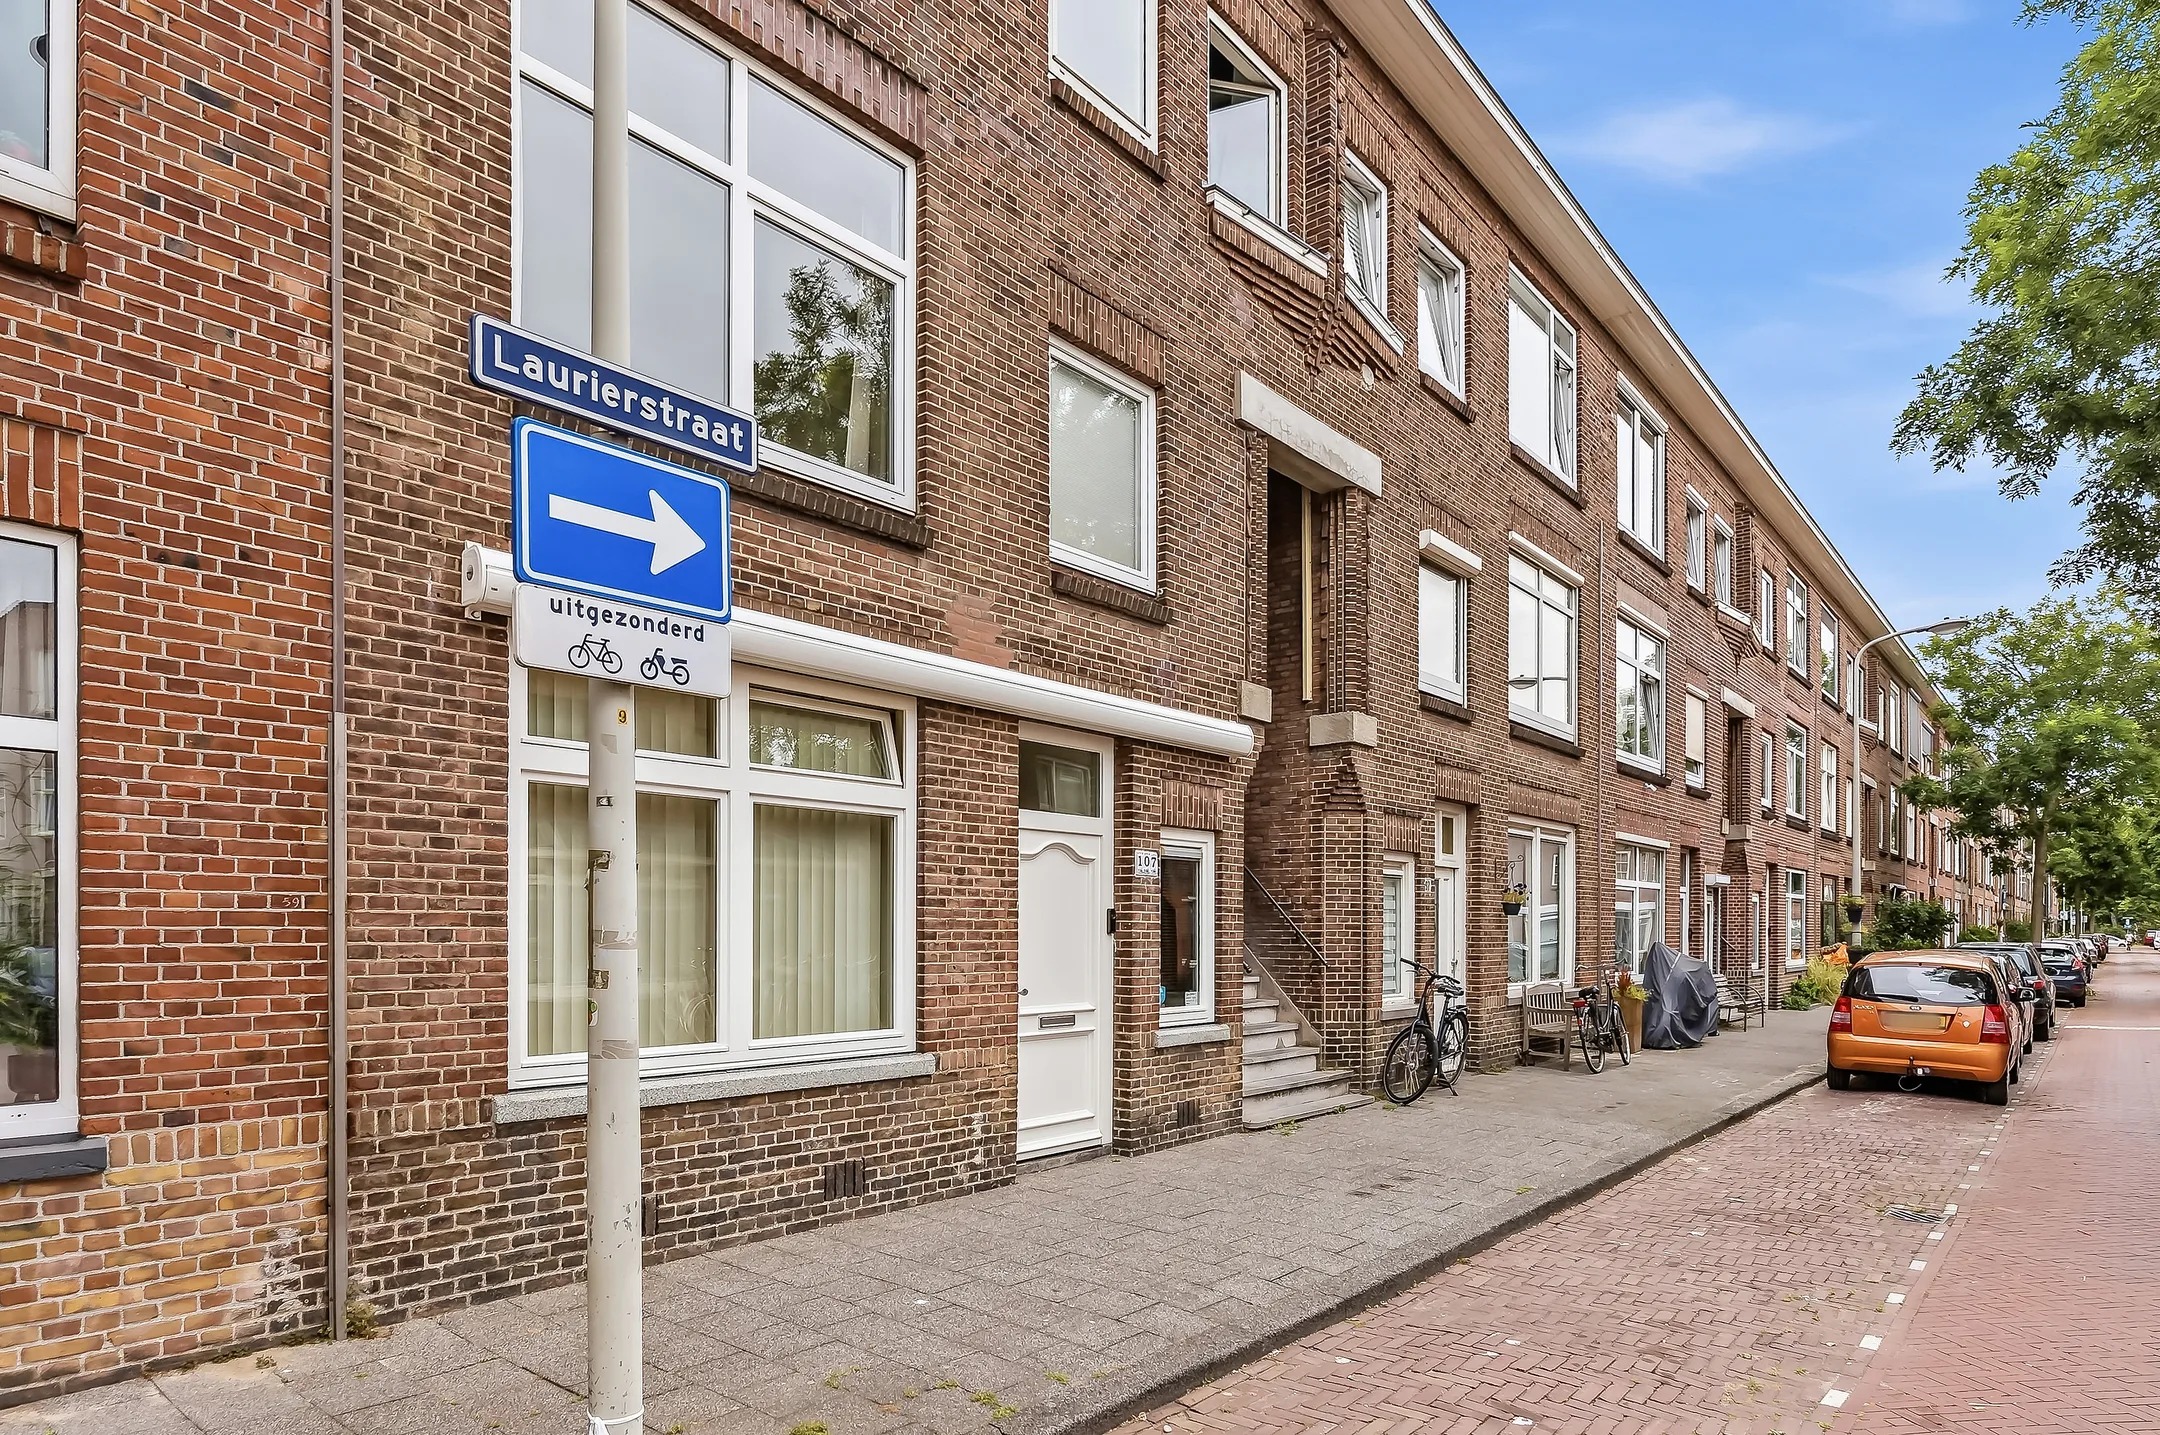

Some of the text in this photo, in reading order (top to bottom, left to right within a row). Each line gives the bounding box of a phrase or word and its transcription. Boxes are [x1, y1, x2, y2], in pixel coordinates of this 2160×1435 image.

[494, 334, 744, 451] Laurierstraat
[550, 597, 705, 642] uitgezonderd
[618, 709, 627, 724] 9
[1138, 855, 1157, 868] 107
